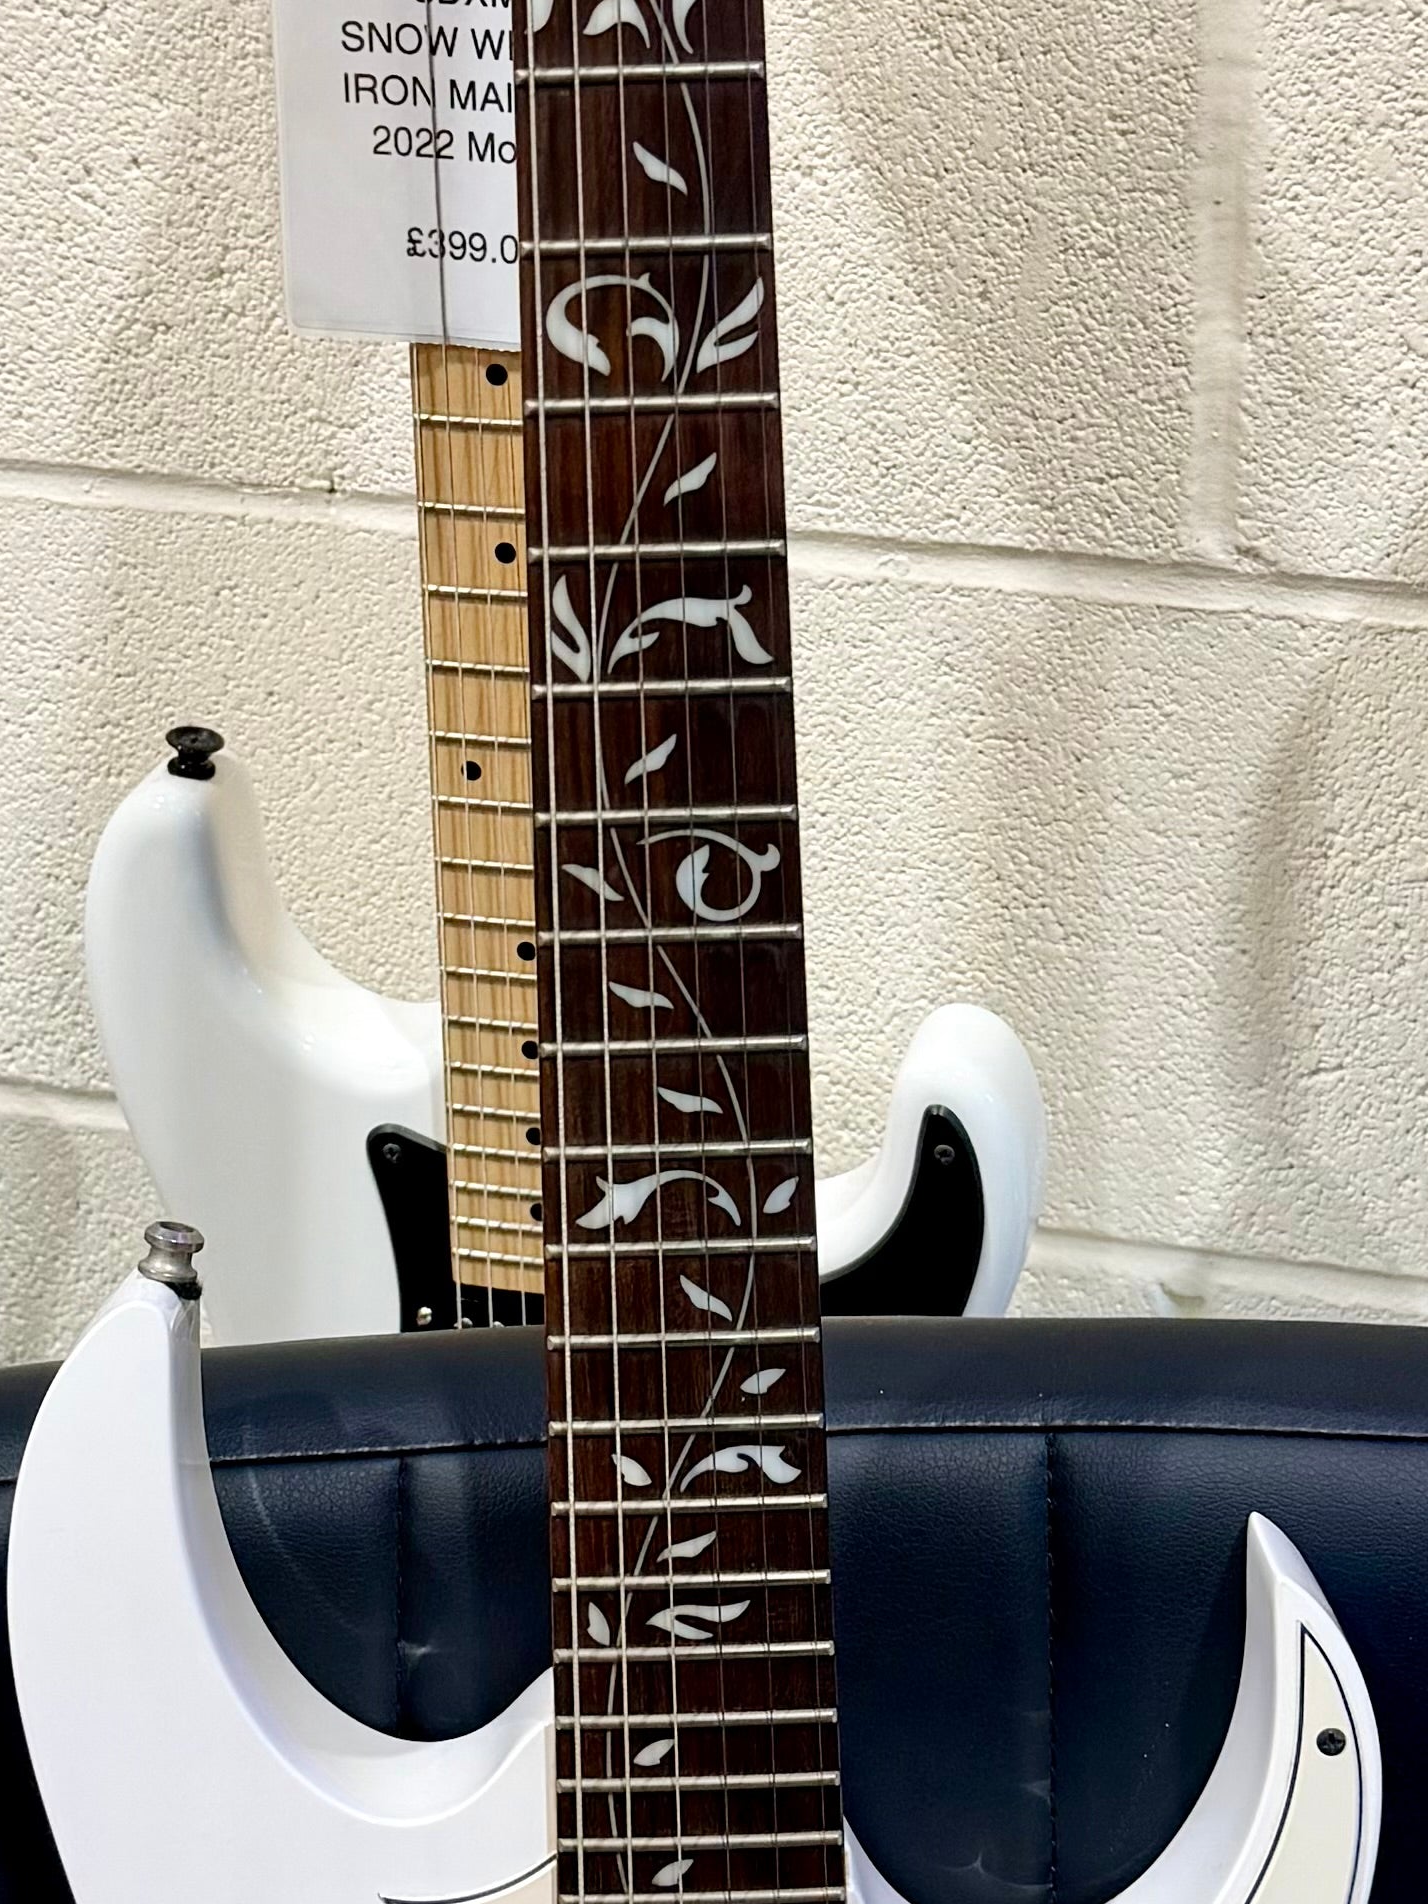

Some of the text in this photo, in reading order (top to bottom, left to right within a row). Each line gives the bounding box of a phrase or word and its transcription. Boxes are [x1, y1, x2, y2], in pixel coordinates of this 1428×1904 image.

[341, 20, 459, 58] SNOW
[343, 72, 513, 114] IRON MAI
[372, 124, 518, 165] 2022 Mo
[406, 226, 520, 265] £399.0
